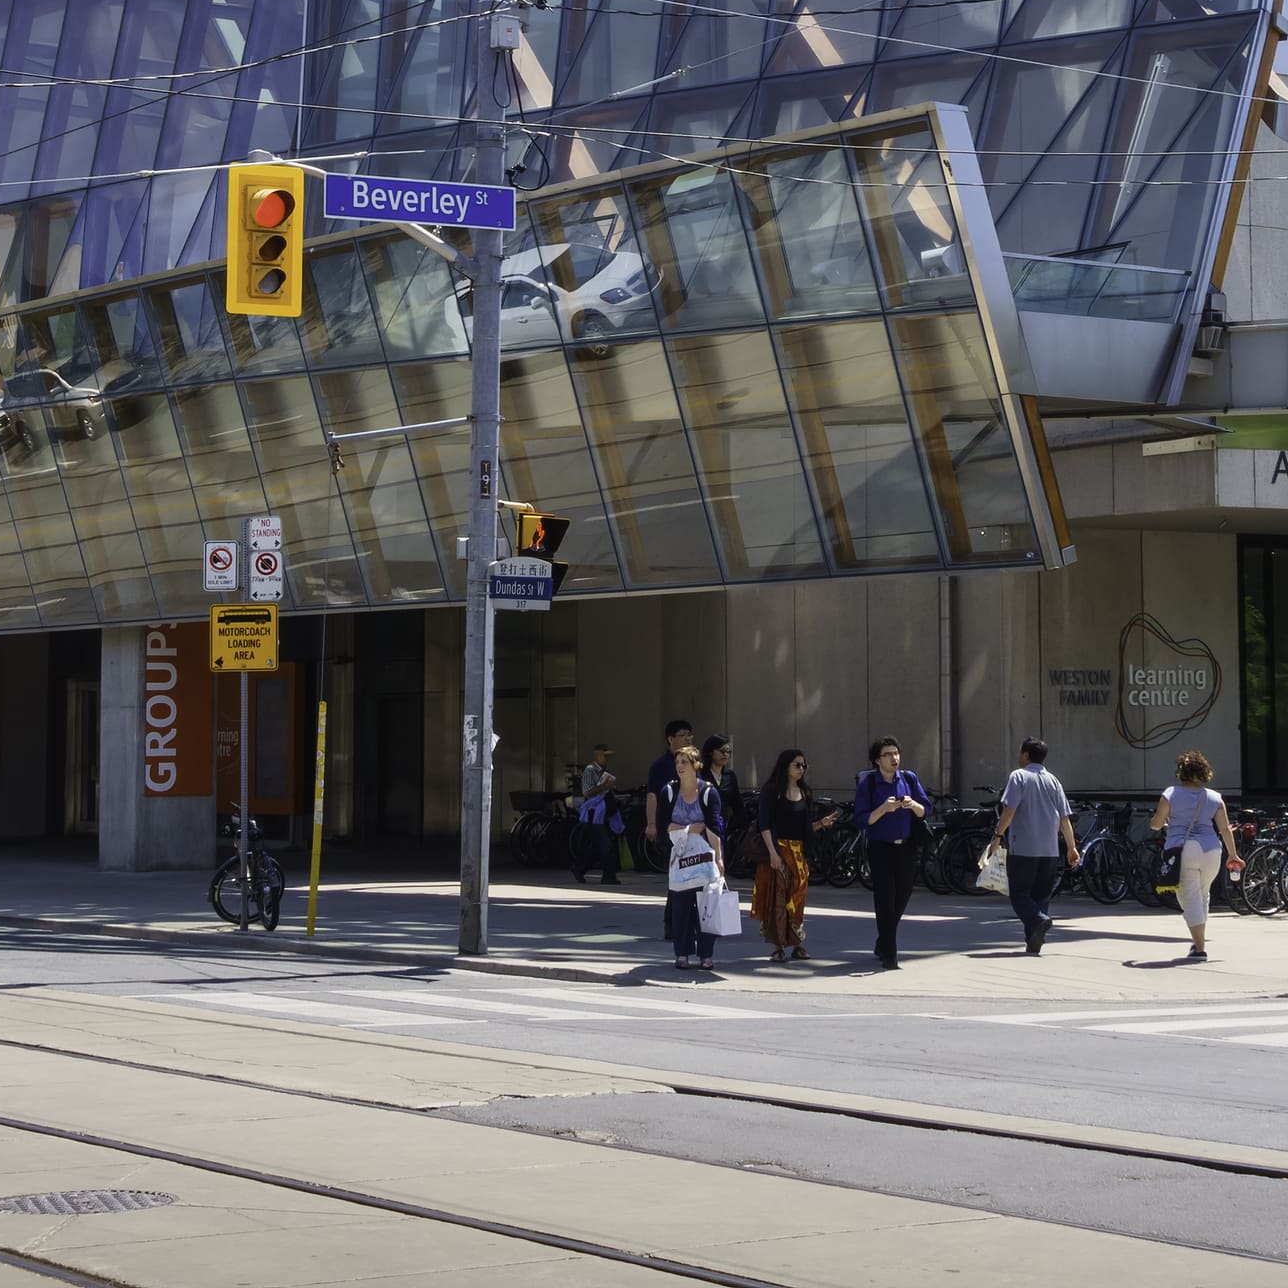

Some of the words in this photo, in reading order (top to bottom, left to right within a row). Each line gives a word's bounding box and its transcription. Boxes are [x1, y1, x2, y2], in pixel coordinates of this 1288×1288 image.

[352, 180, 470, 223] Beverley
[475, 190, 489, 206] St
[260, 518, 271, 527] NO
[251, 528, 281, 538] STANDING
[495, 579, 526, 596] Dundas
[527, 583, 534, 596] St
[537, 581, 545, 596] W
[218, 627, 271, 637] MOTORCOACH
[227, 639, 261, 649] LOADING
[233, 650, 255, 660] AREA
[1049, 669, 1111, 686] WESTON
[1128, 663, 1207, 689] learning
[1059, 690, 1111, 706] FAMILY
[1128, 686, 1189, 706] centre
[217, 727, 239, 745] rning
